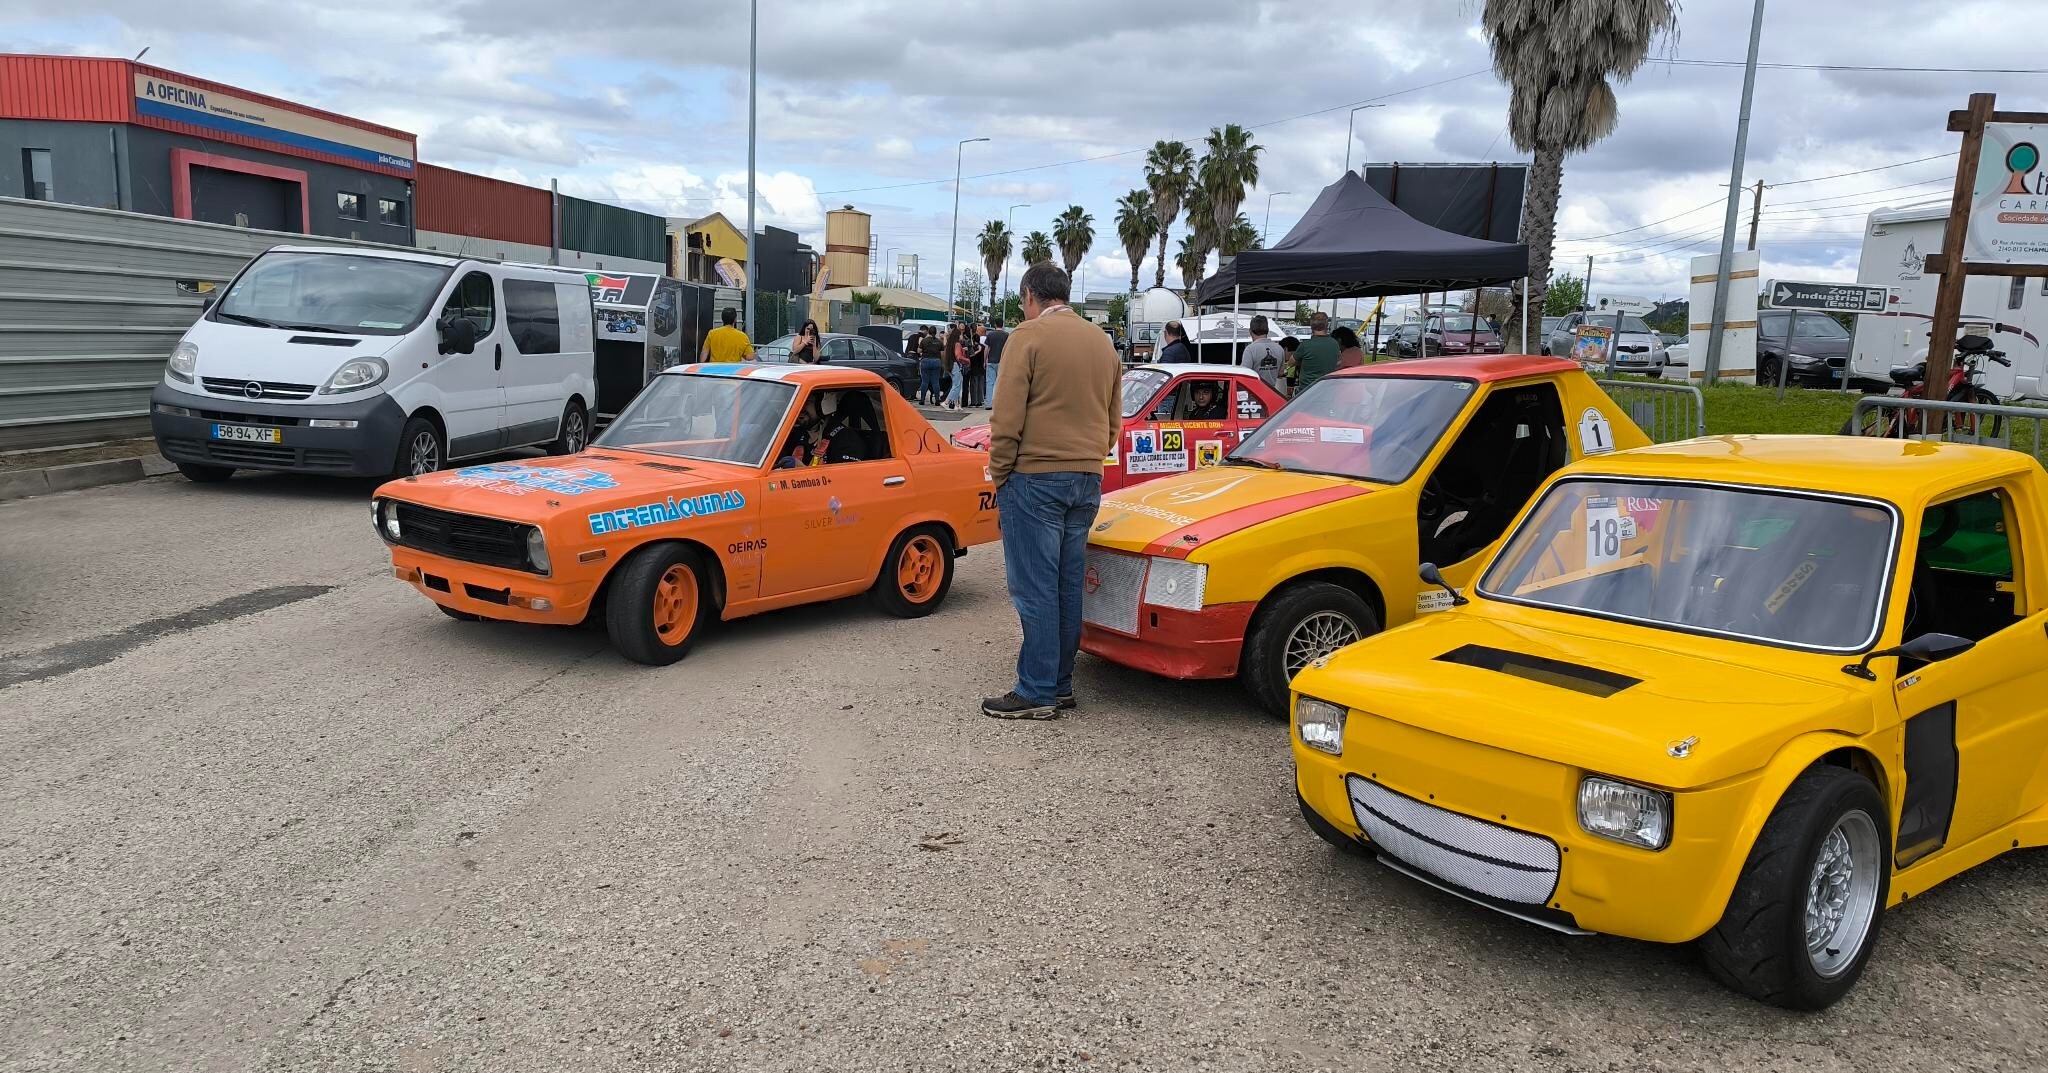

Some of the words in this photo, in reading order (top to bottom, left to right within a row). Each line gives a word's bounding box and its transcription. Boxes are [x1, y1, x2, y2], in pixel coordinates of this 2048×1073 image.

[146, 81, 156, 97] A
[158, 83, 206, 109] OFICINA
[2003, 213, 2039, 223] Sociedade
[1796, 291, 1863, 303] Industrial
[1828, 287, 1864, 297] Zona
[1824, 299, 1862, 309] (Este)
[1183, 421, 1209, 429] VICENTE
[1163, 433, 1182, 449] 29
[1591, 423, 1603, 447] 1
[780, 479, 790, 491] M.
[791, 479, 821, 489] Gamboa
[588, 490, 746, 534] ENTREMÁQUINAS
[804, 517, 833, 530] SILVER
[1589, 518, 1619, 557] 18
[728, 538, 767, 554] OEIRAS
